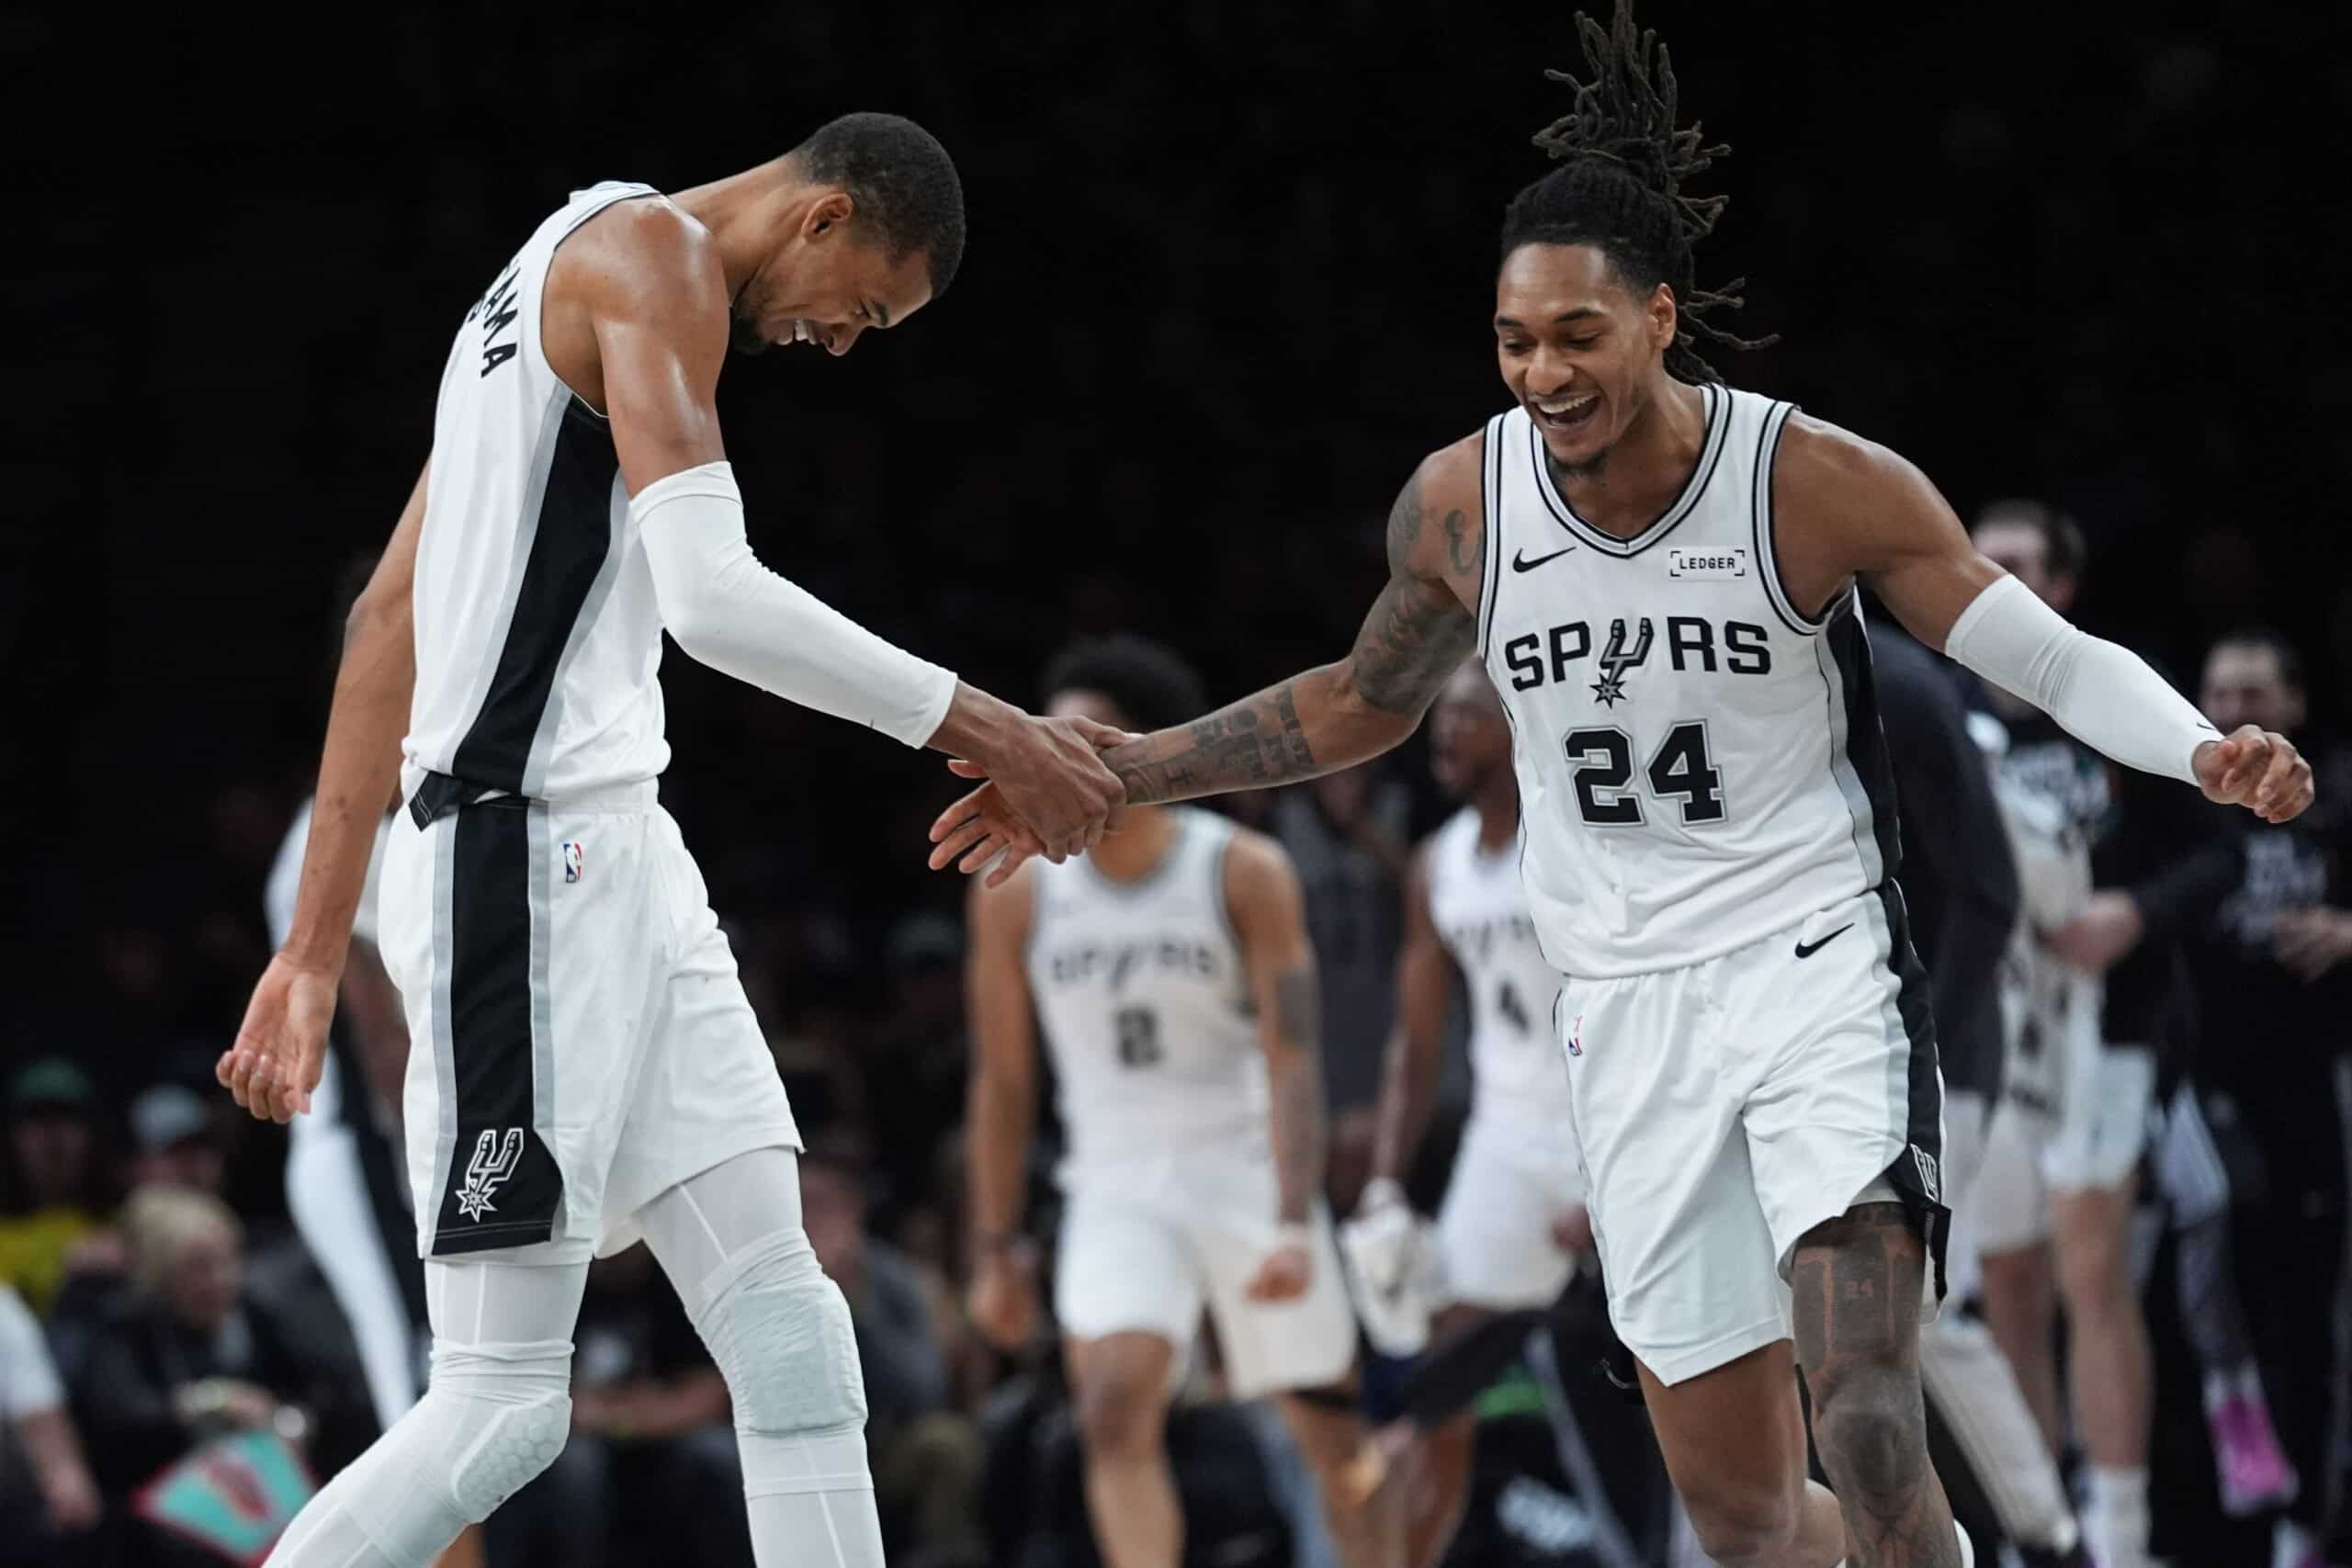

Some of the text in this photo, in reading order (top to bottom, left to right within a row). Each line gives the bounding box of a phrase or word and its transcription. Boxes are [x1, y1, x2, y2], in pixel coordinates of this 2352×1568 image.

[1679, 558, 1736, 570] LEDGER
[1505, 616, 1771, 709] SPURS
[1562, 718, 1728, 826] 24
